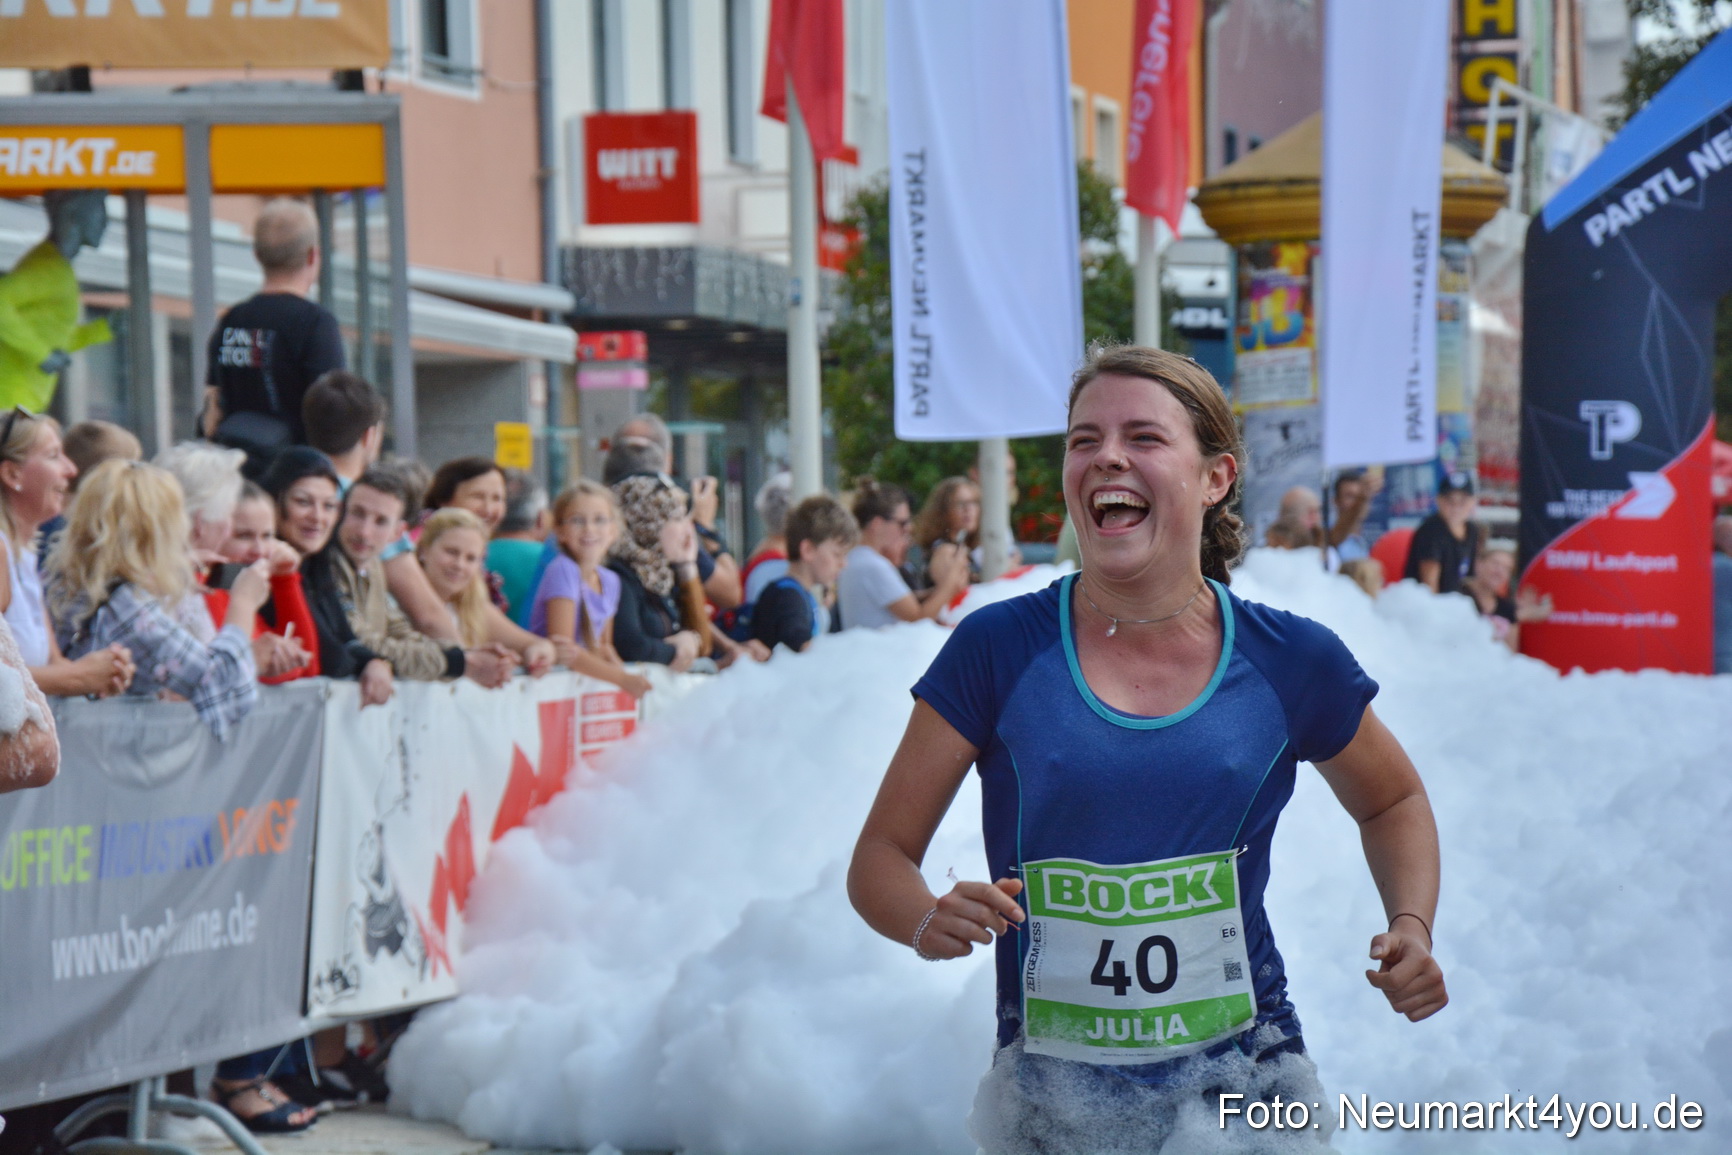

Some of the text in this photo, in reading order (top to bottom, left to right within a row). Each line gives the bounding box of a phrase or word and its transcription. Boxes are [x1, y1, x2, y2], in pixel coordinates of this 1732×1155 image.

[597, 146, 679, 181] WITT
[1583, 125, 1732, 248] PARTL NE
[1, 825, 93, 890] OFFICE
[1046, 863, 1219, 917] BOCK
[1221, 926, 1237, 939] E6
[1090, 934, 1179, 996] 40
[1086, 1013, 1190, 1041] JULIA
